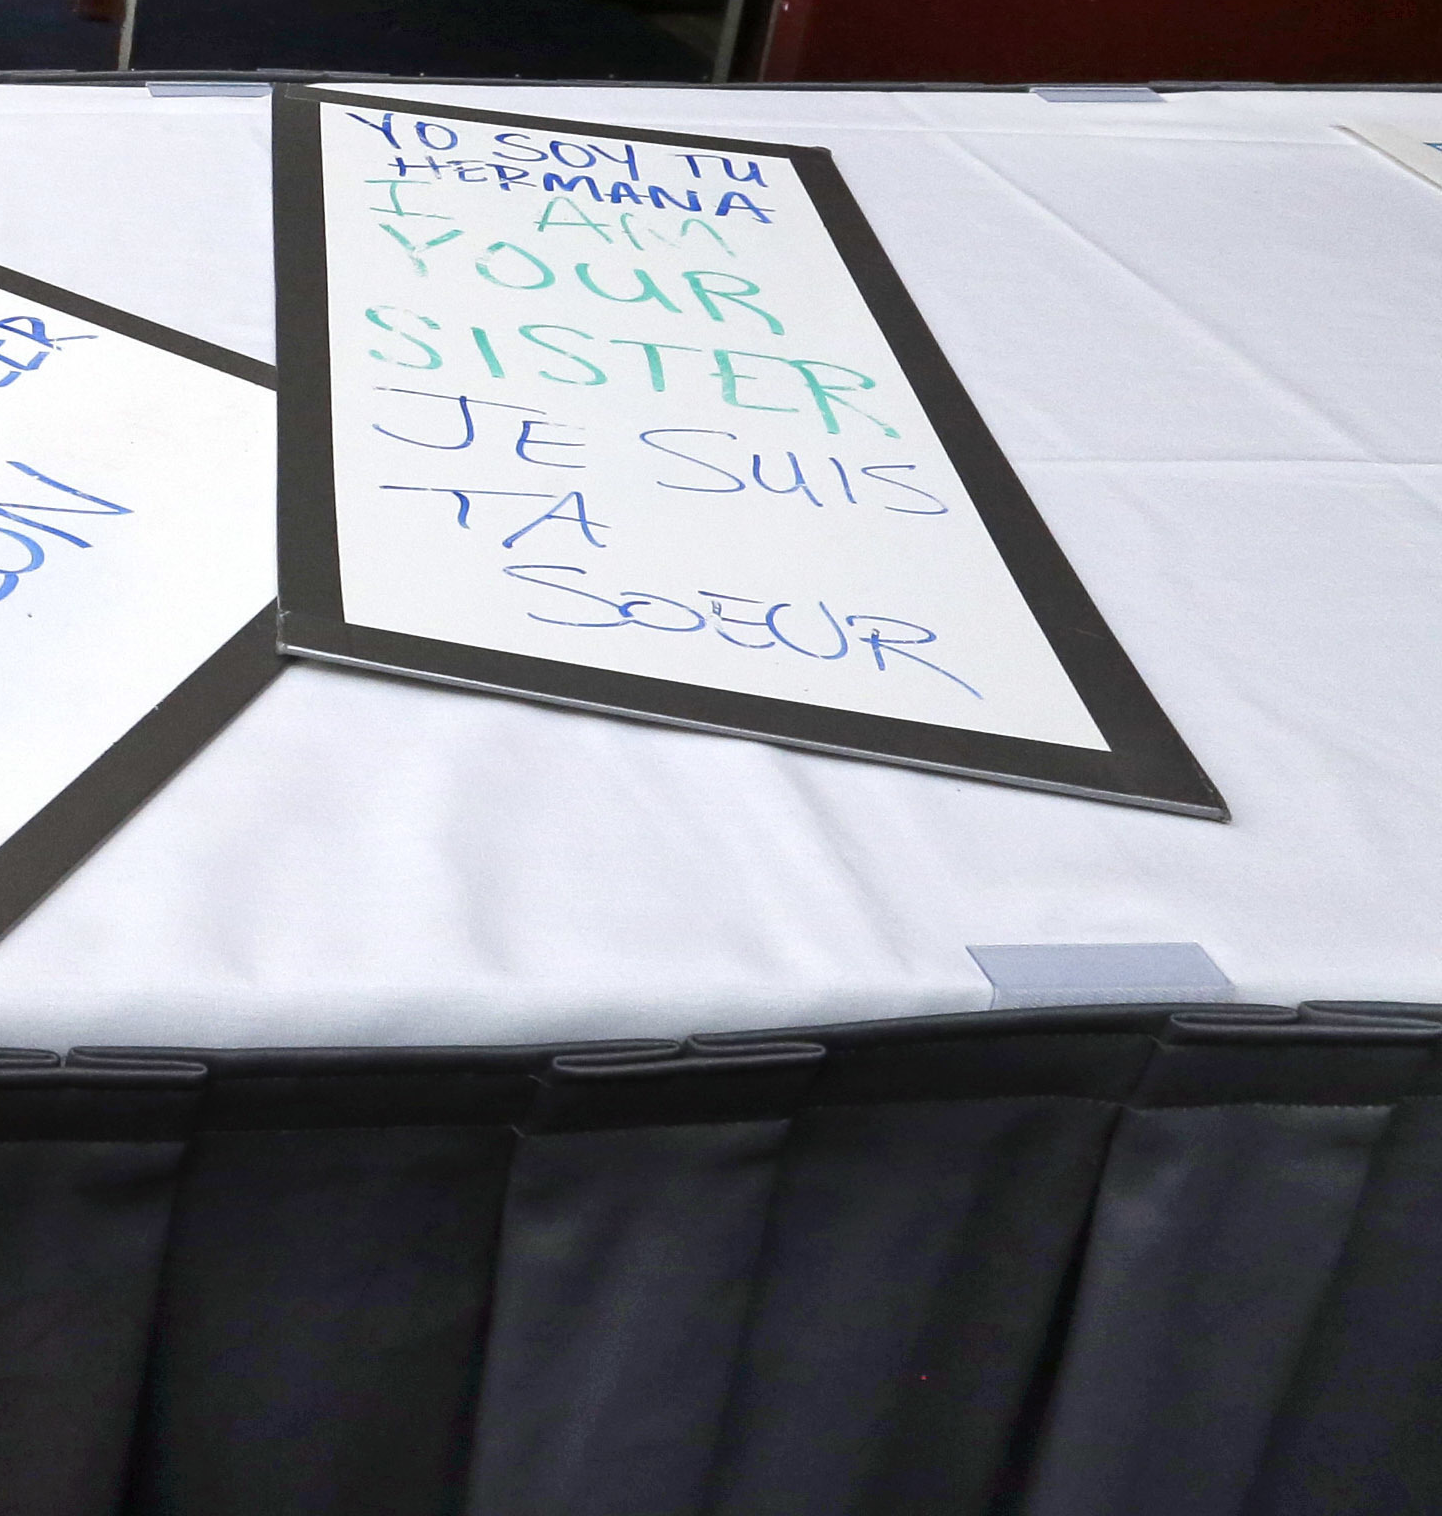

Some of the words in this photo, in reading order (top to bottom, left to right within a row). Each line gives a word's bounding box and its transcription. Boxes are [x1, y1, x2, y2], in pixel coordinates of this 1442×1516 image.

[345, 112, 460, 151] YO
[491, 132, 641, 183] SOY
[674, 153, 771, 188] TU
[387, 155, 777, 225] HERMANA
[363, 179, 455, 221] I
[377, 221, 786, 336] YOUR
[364, 304, 903, 440] SISTER
[371, 385, 588, 470] JE
[639, 427, 950, 516] SUIS
[378, 484, 613, 549] TA
[501, 564, 985, 701] SOEUR
